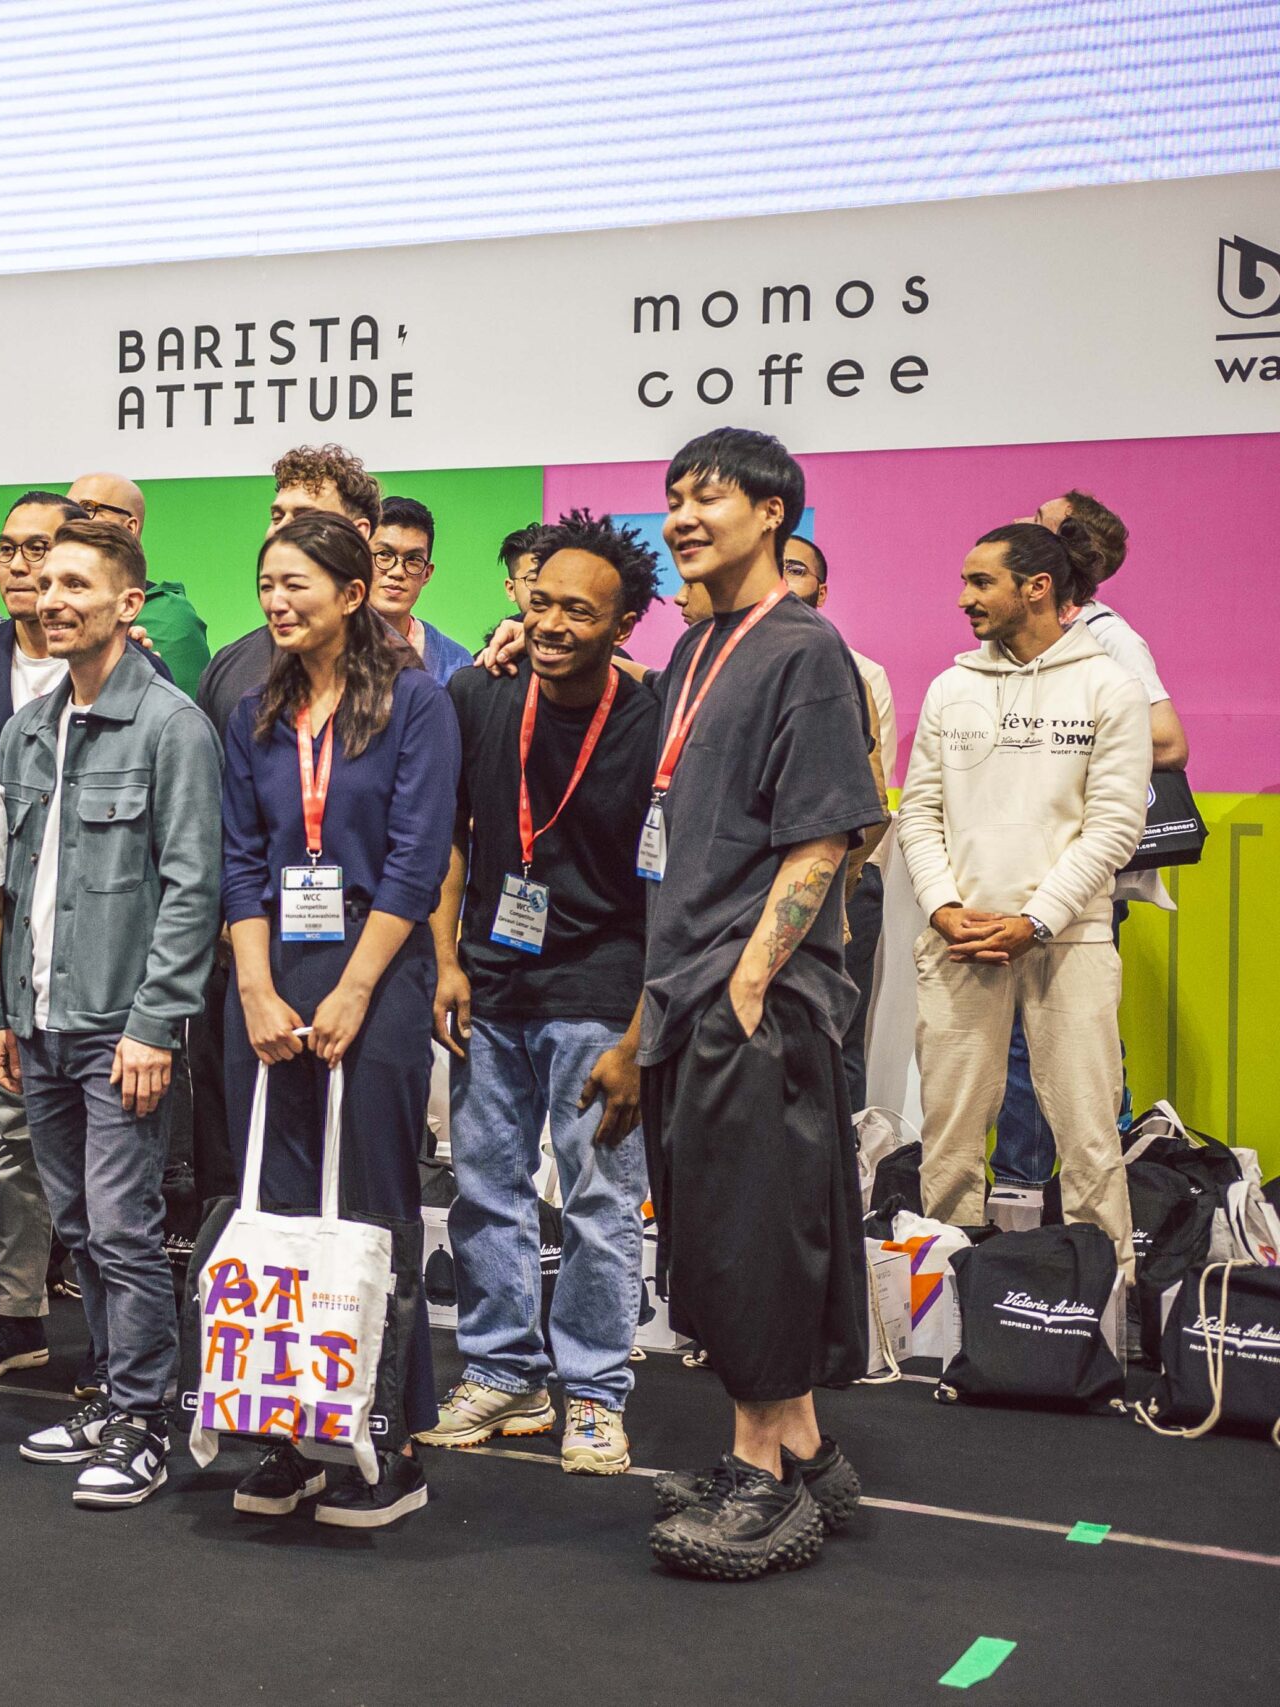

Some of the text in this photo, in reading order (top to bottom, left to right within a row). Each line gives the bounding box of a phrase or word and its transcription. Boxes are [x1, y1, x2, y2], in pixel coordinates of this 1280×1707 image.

[632, 274, 931, 334] momos
[118, 314, 379, 374] BARISTA
[637, 352, 930, 408] coffee
[117, 371, 414, 430] ATTITUDE
[1162, 823, 1195, 832] cleaners
[303, 893, 322, 902] WCC
[515, 902, 532, 913] WCC
[540, 1243, 562, 1256] duino
[312, 1291, 357, 1302] BARISTA
[1001, 1290, 1095, 1316] Victoria Arduino
[311, 1301, 360, 1312] ATTITUDE
[1000, 1319, 1032, 1330] INSPIRED
[1044, 1326, 1063, 1334] YOUR
[1236, 1351, 1257, 1360] YOUR
